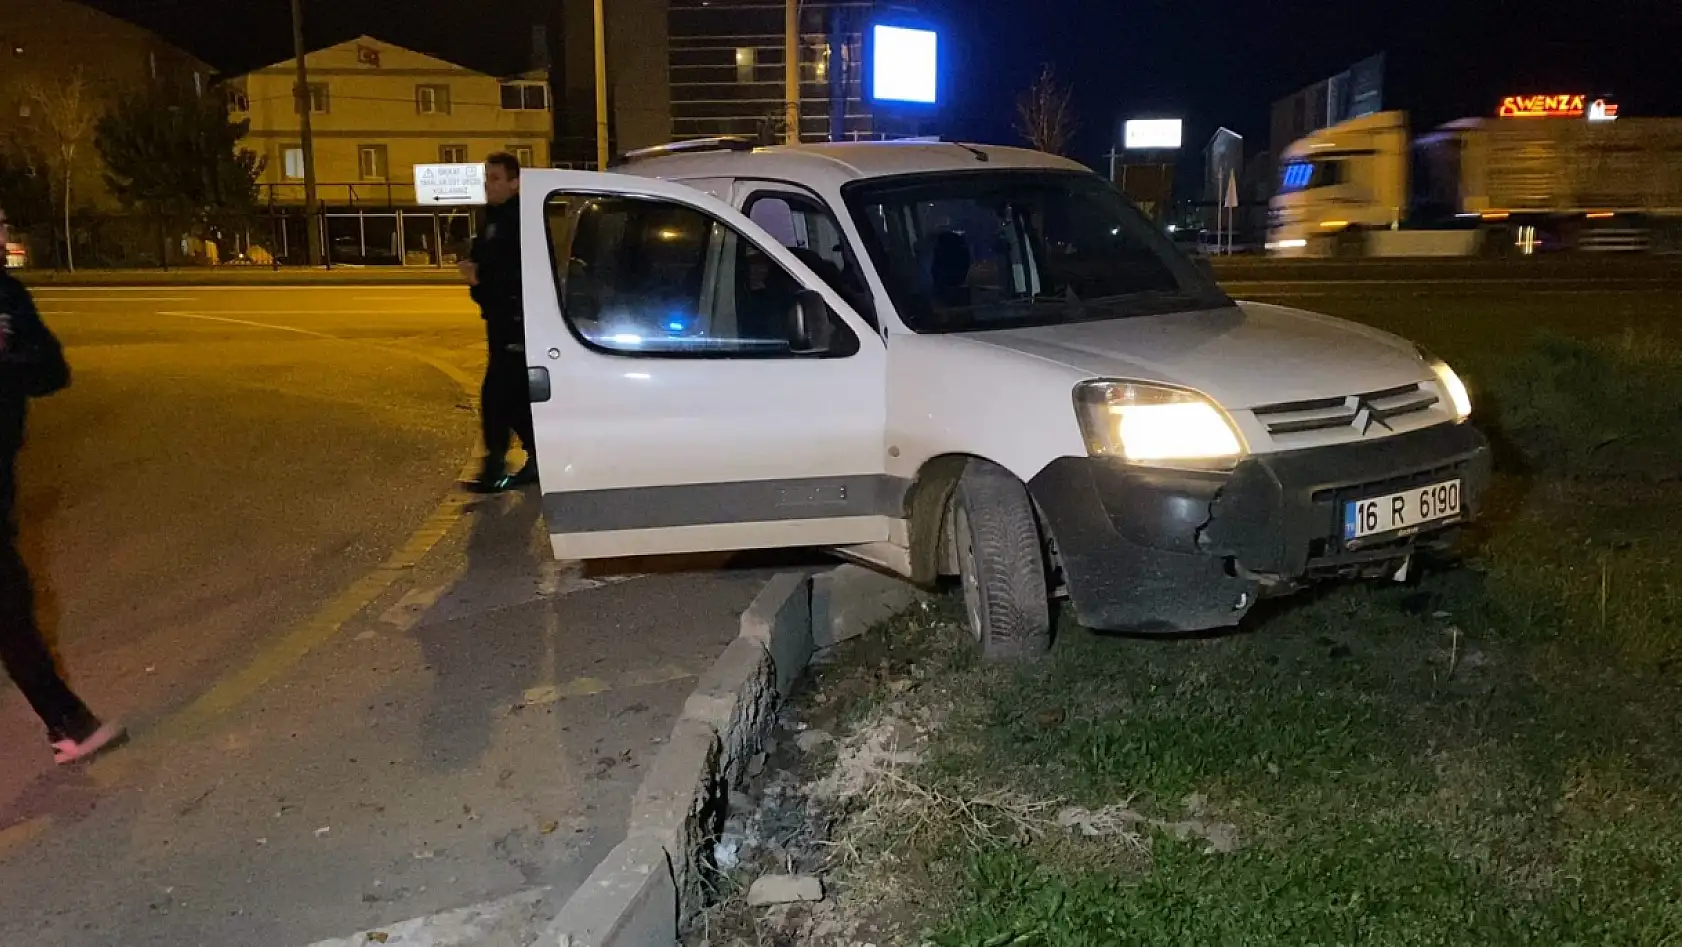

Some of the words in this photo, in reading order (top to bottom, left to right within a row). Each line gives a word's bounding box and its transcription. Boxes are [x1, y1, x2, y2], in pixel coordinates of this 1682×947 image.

[1500, 94, 1584, 117] SWENZA
[1358, 501, 1378, 534] 16
[1391, 496, 1405, 526] R
[1420, 483, 1458, 518] 6190
